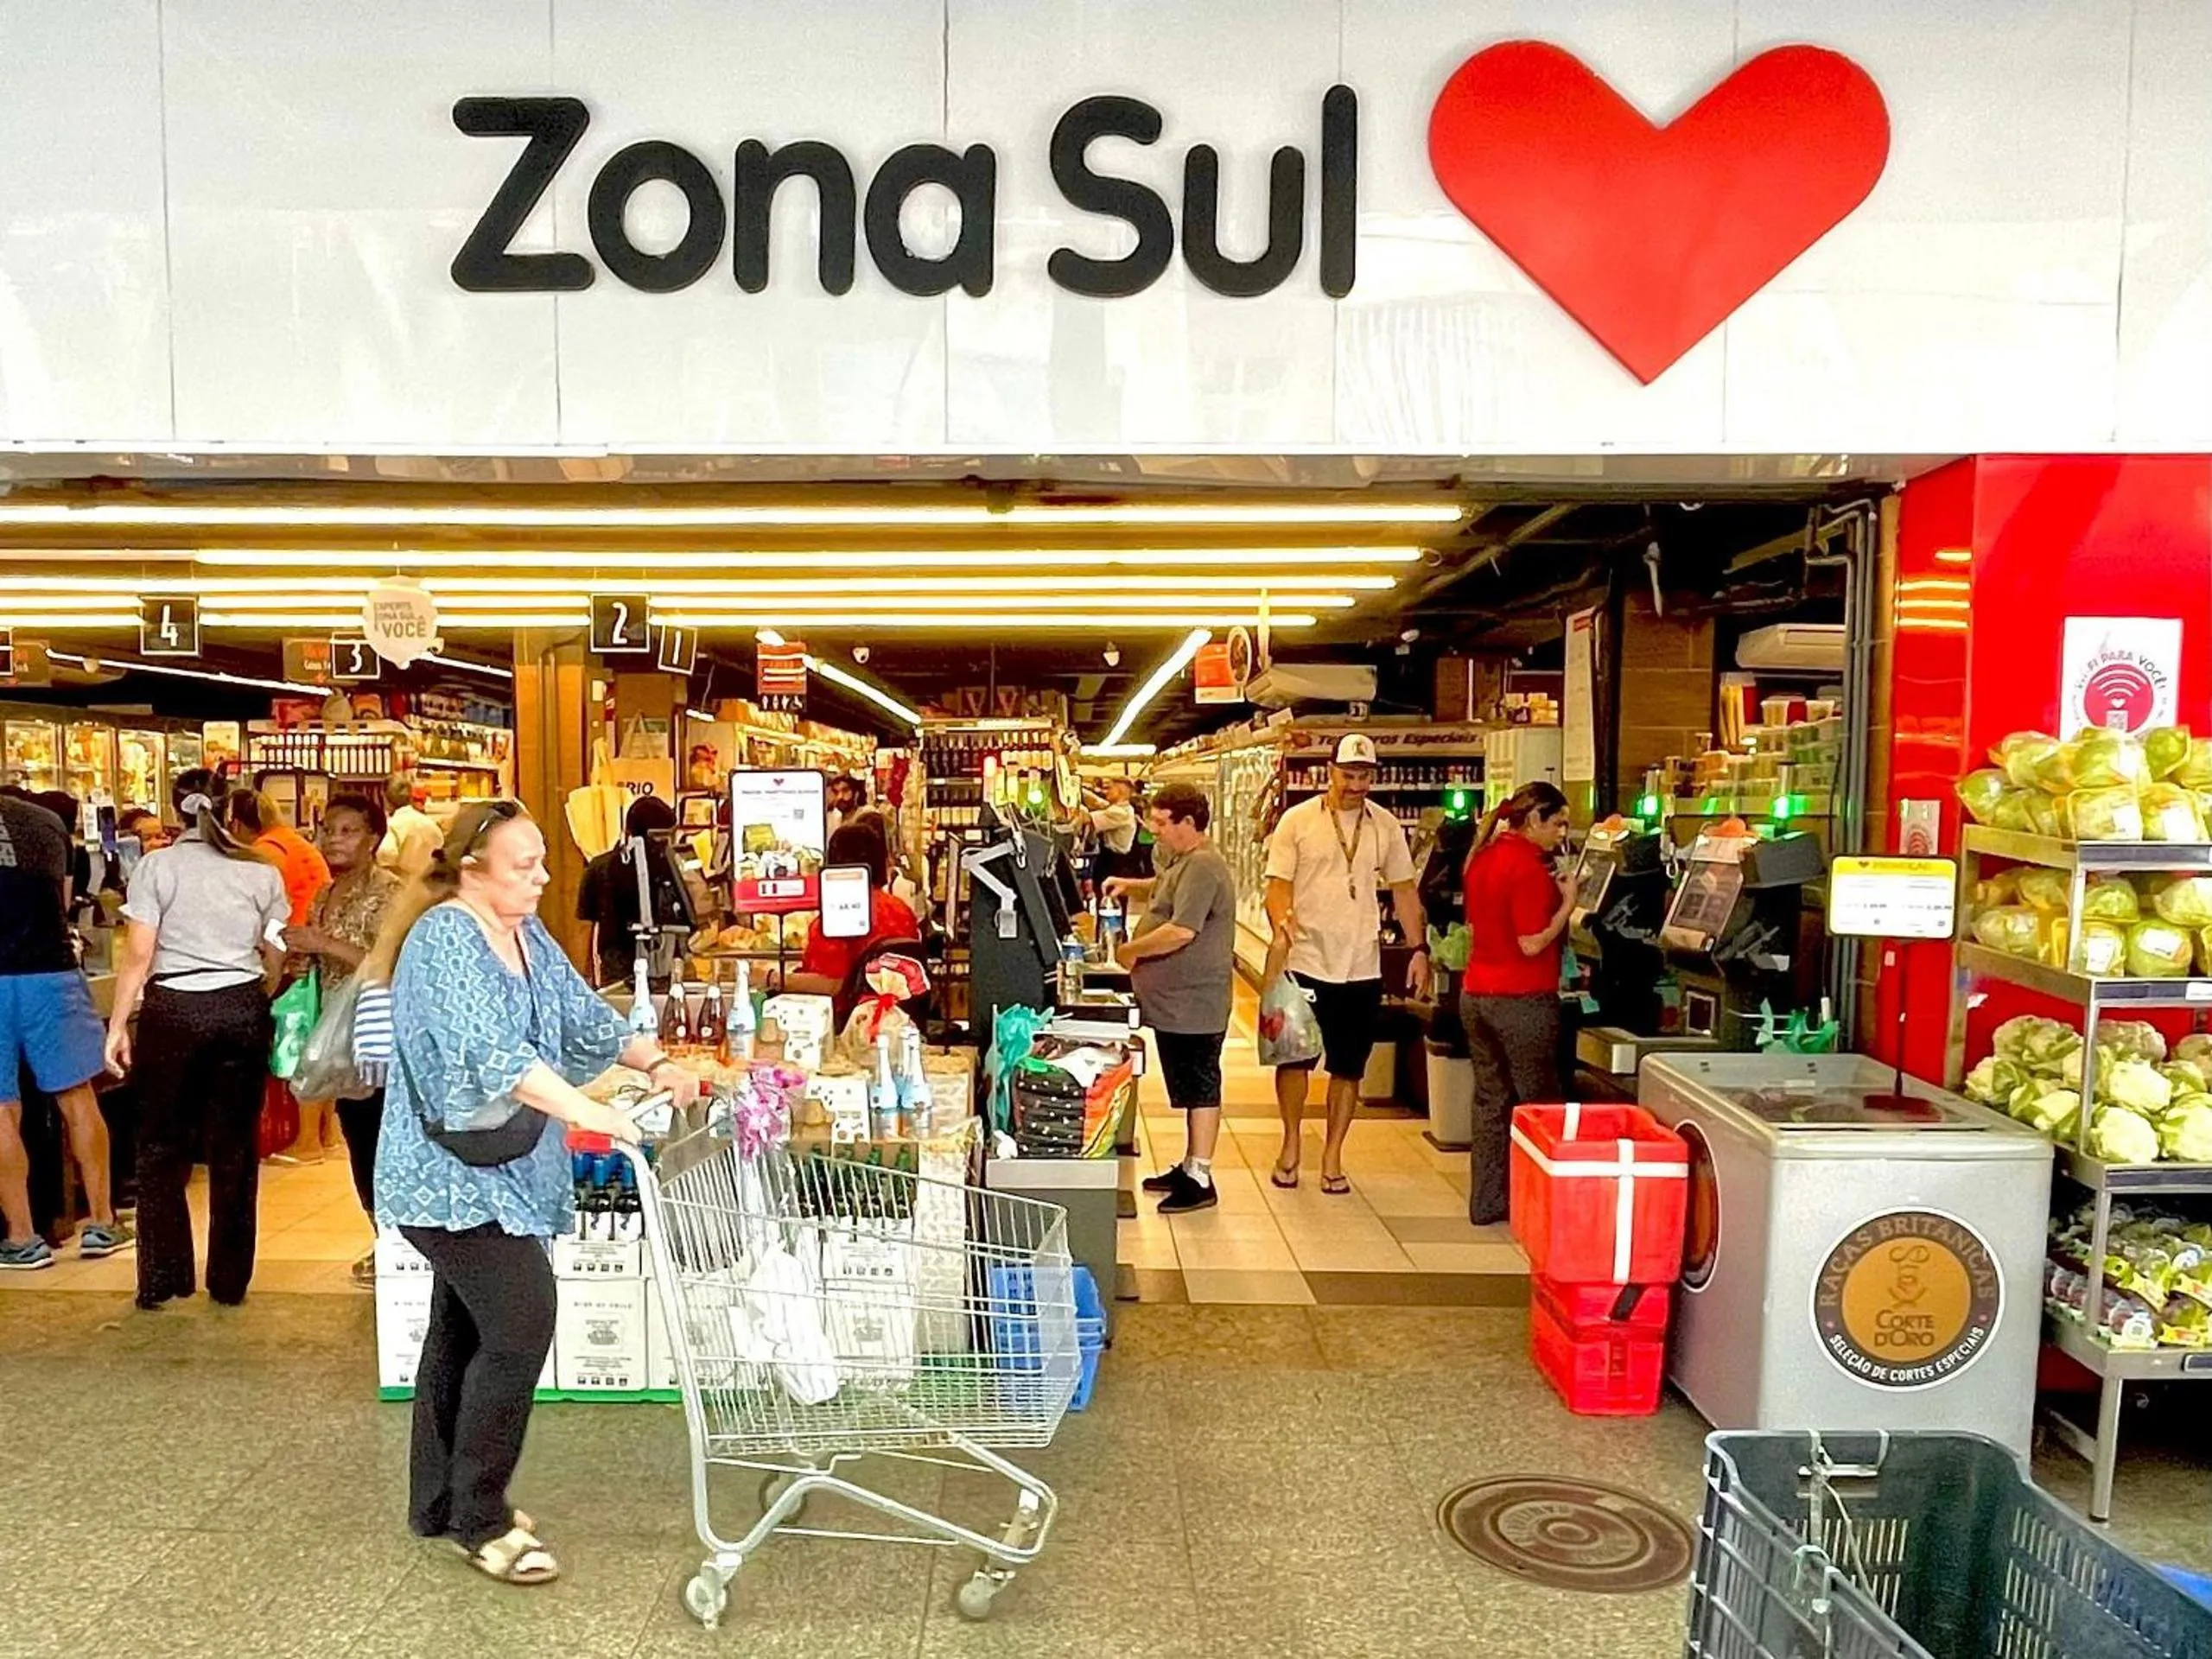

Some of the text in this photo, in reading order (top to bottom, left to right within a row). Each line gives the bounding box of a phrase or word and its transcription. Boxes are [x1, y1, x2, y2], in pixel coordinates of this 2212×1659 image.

[451, 84, 1357, 299] Zona Sul
[161, 604, 178, 647] 4
[612, 601, 627, 644] 2
[349, 642, 363, 673] 3
[671, 629, 682, 665] 1
[1875, 1308, 1935, 1329] CORTE
[1870, 1365, 1889, 1380] DE
[1889, 1365, 1936, 1382] CORTES
[1935, 1326, 1986, 1374] ESPECIAIS
